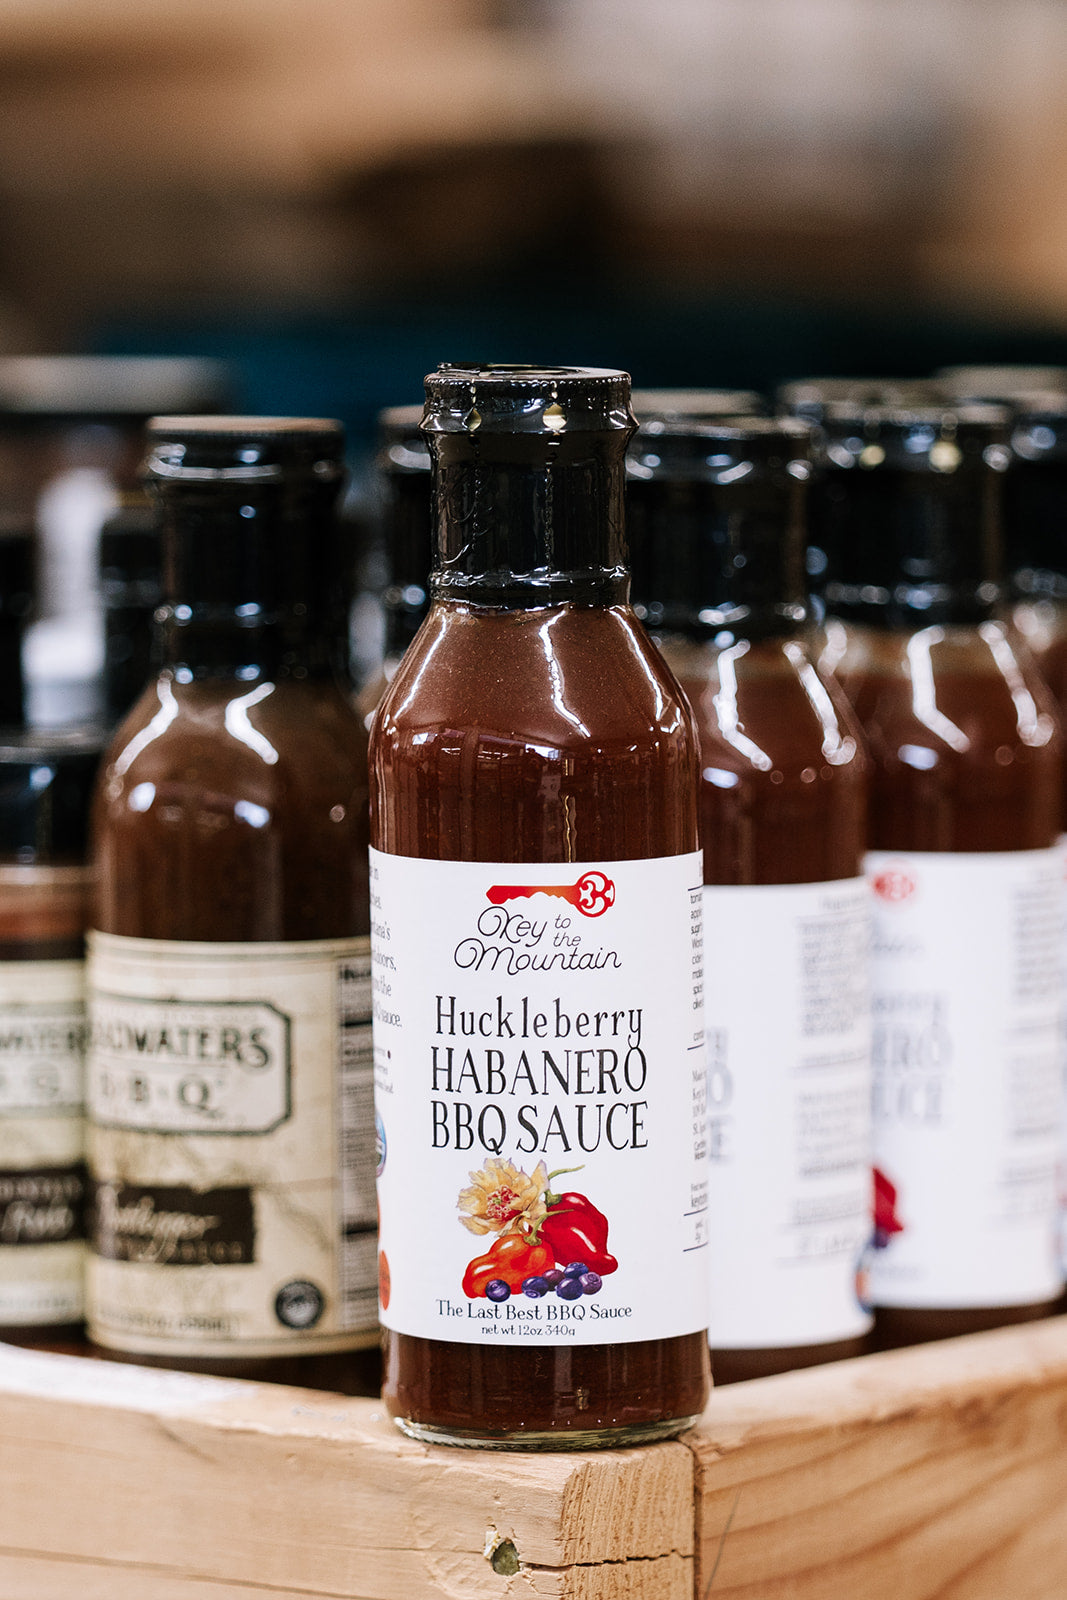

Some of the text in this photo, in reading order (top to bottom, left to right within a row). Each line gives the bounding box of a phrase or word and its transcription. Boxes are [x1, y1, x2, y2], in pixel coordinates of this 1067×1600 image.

[477, 906, 571, 948] Key to
[553, 932, 581, 948] the
[454, 937, 622, 975] Mountain
[434, 994, 644, 1050] Huckleberry
[429, 1044, 649, 1097] HABANERO
[430, 1099, 508, 1155] BBQ
[514, 1099, 651, 1154] SAUCE
[436, 1300, 632, 1320] The Last Best BBQ Sauce
[482, 1324, 498, 1334] net
[501, 1325, 515, 1335] wt
[519, 1325, 542, 1335] 12oz
